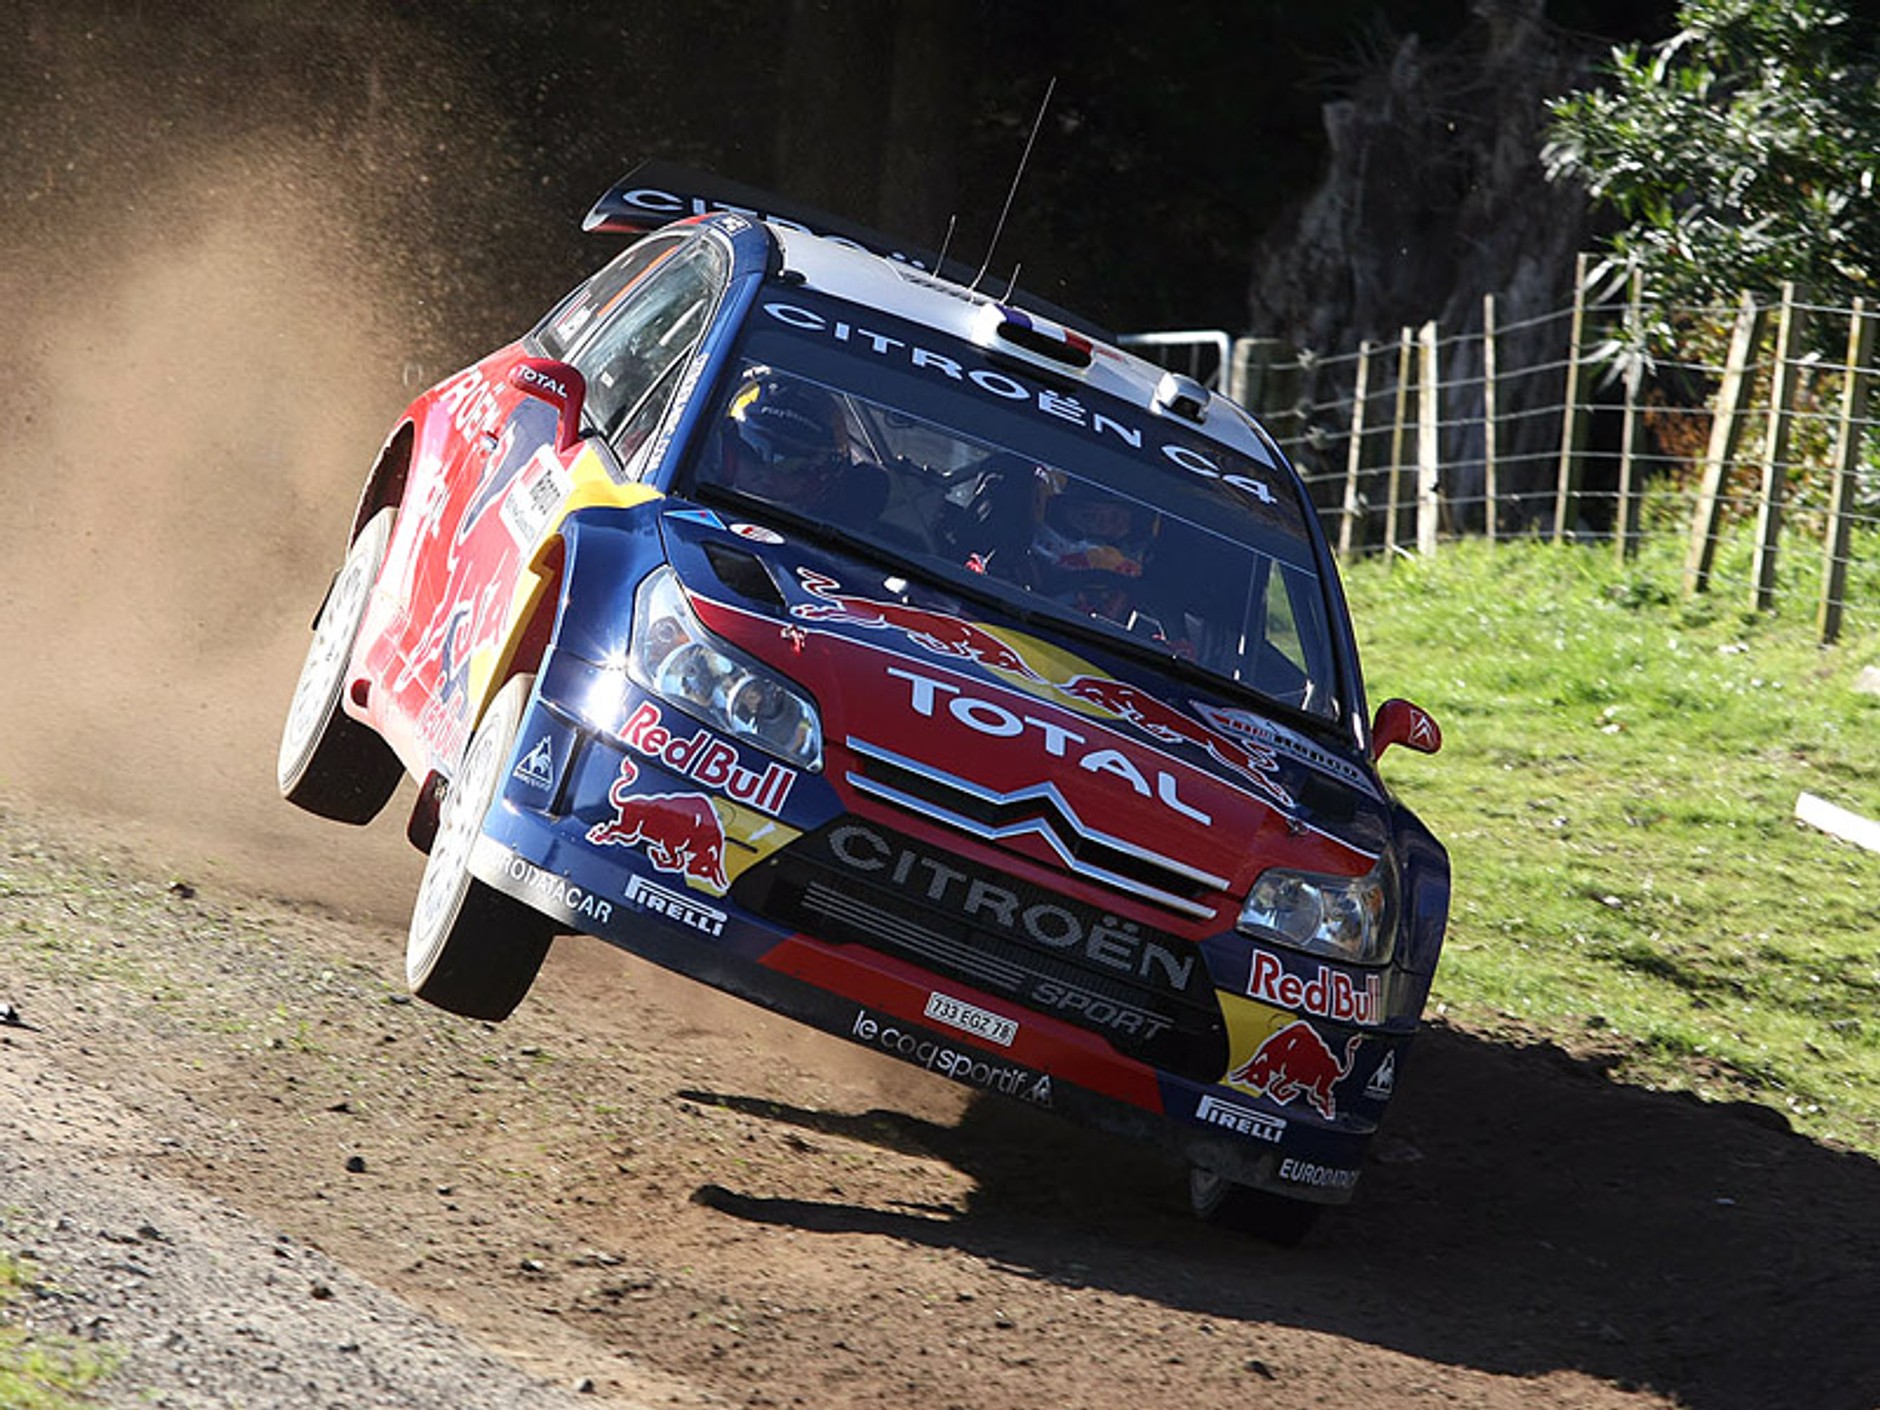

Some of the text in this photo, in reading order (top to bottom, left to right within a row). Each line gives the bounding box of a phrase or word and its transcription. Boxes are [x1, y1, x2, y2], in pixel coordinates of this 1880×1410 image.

[515, 362, 568, 398] TOTAL
[763, 302, 1142, 448] CITROËN
[1161, 445, 1278, 504] C4
[887, 667, 1212, 827] TOTAL
[623, 874, 728, 937] PIRELLI
[827, 825, 1195, 991] CITROËN
[1030, 981, 1174, 1042] SPORT
[1195, 1094, 1288, 1144] PIRELLI
